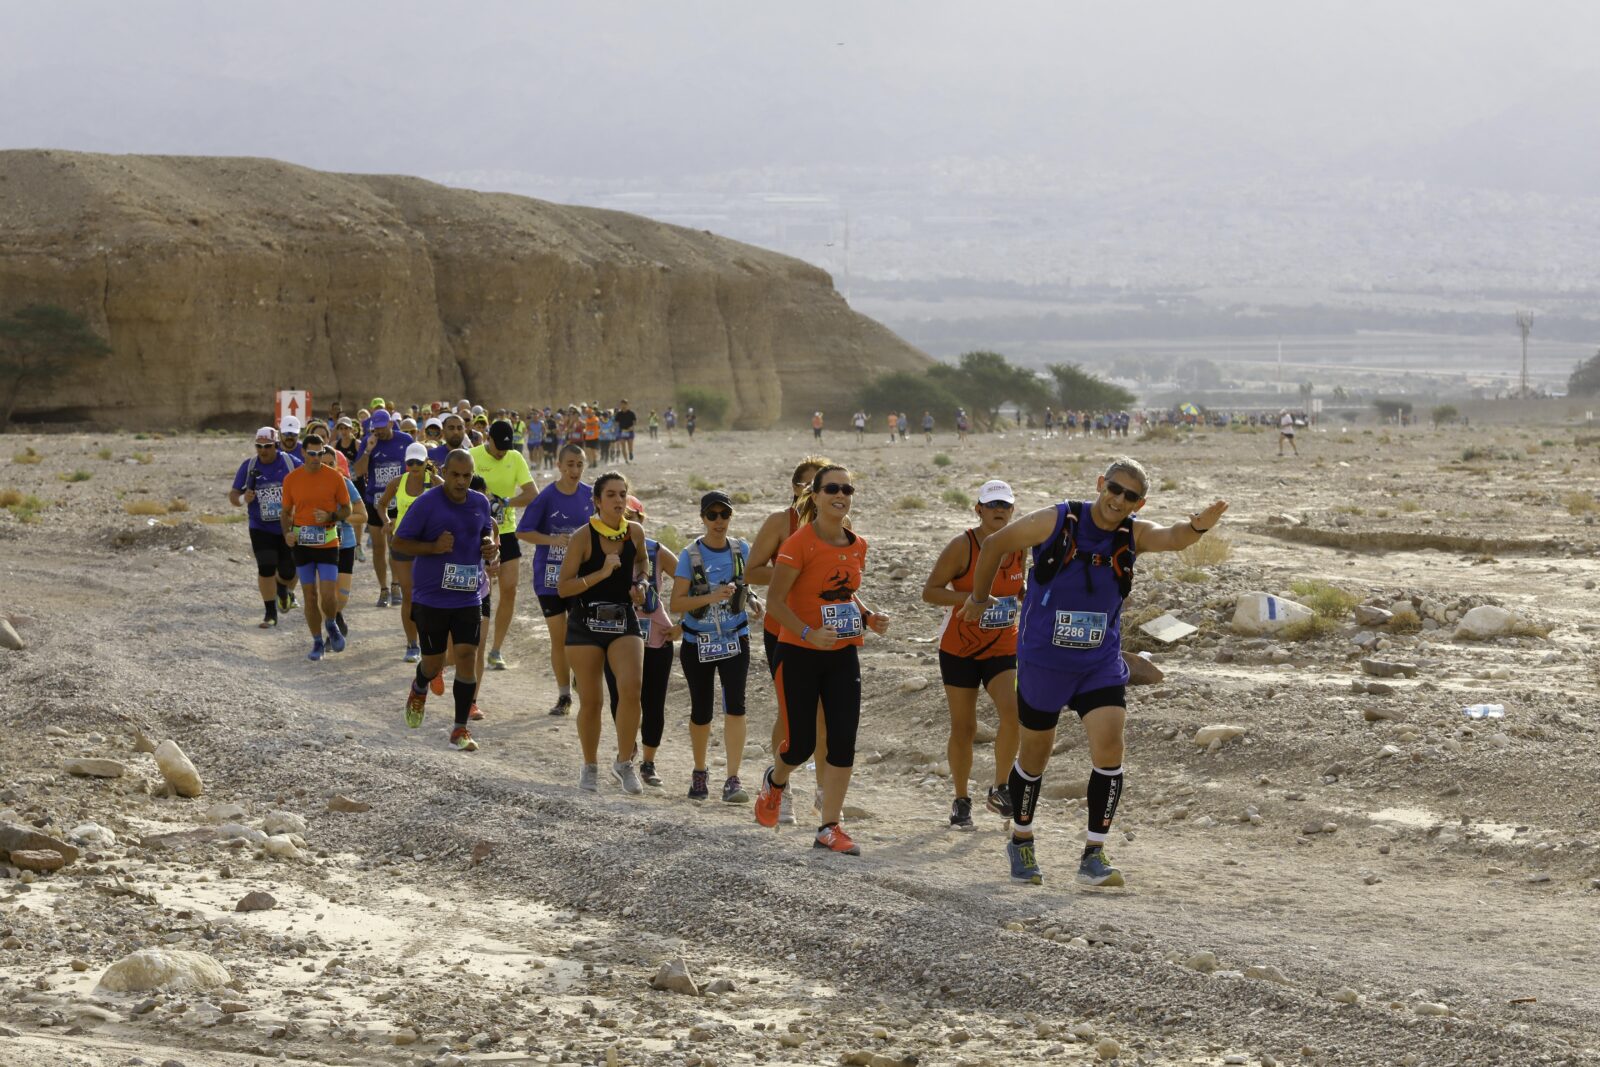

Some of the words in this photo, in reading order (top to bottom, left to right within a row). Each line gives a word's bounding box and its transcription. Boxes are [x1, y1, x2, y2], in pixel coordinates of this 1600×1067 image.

[445, 574, 465, 584] 2713
[983, 611, 1003, 621] 2111
[1056, 625, 1085, 638] 2286
[700, 644, 722, 654] 2729
